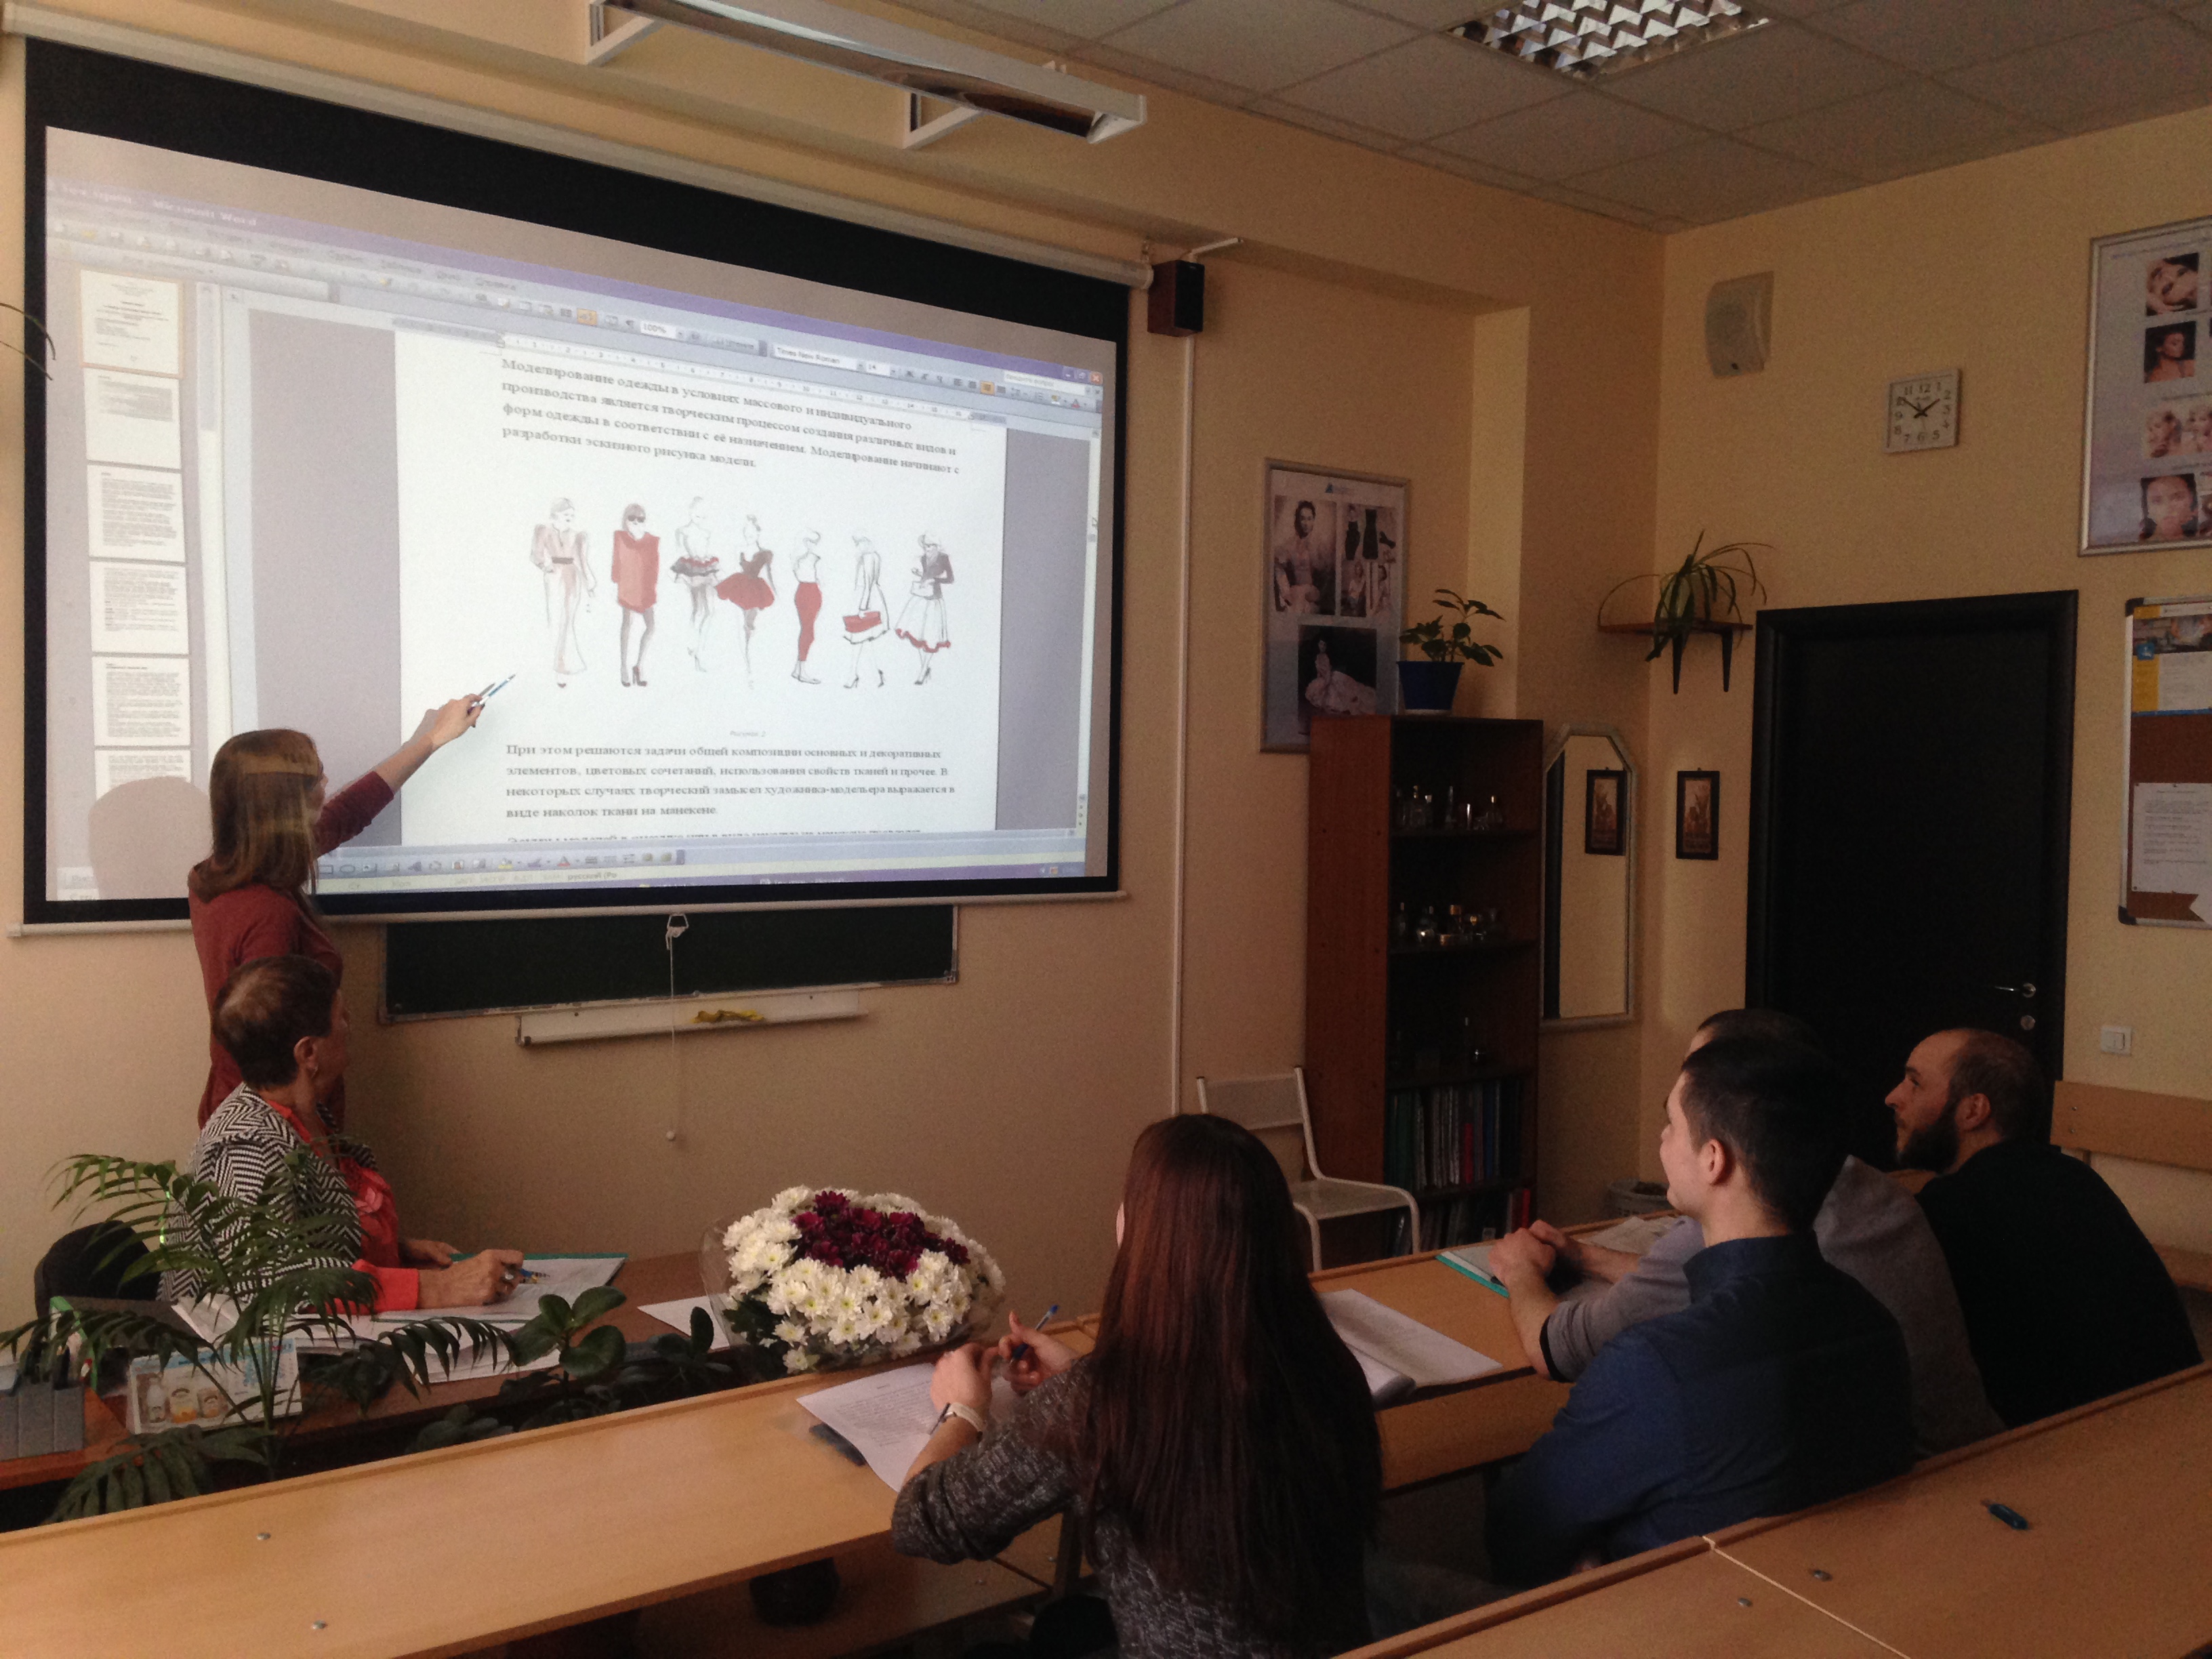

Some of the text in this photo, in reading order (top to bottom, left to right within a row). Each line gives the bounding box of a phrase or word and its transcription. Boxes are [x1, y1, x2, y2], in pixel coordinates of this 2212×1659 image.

[502, 359, 614, 384] Моделирование
[617, 379, 669, 393] одежды
[682, 388, 739, 403] условиях
[743, 398, 802, 413] массового
[816, 409, 912, 430] индивидуального
[502, 383, 596, 403] производства
[601, 398, 658, 412] является
[662, 406, 734, 424] творческим
[737, 417, 800, 432] процессом
[803, 428, 853, 441] создания
[855, 435, 913, 449] различных
[916, 444, 946, 453] видов
[503, 403, 542, 417] форм
[546, 411, 599, 425] одежды
[614, 421, 699, 438] соответствии
[714, 432, 726, 442] её
[811, 447, 898, 466] Моделирование
[901, 460, 951, 473] начинают
[503, 428, 581, 445] разработки
[586, 438, 651, 453] эскизного
[654, 448, 705, 460] рисунка
[507, 745, 535, 756] При
[575, 747, 641, 757] решаются
[689, 747, 728, 756] общей
[869, 751, 941, 759] декоративных
[651, 766, 716, 775] сочетаний,
[808, 767, 850, 775] свойств
[854, 767, 888, 775] тканей
[506, 789, 580, 798] некоторых
[585, 788, 635, 798] случаях
[640, 785, 710, 797] творческий
[765, 787, 885, 796] художника-модельера
[888, 787, 947, 795] выражается
[507, 810, 539, 818] виде
